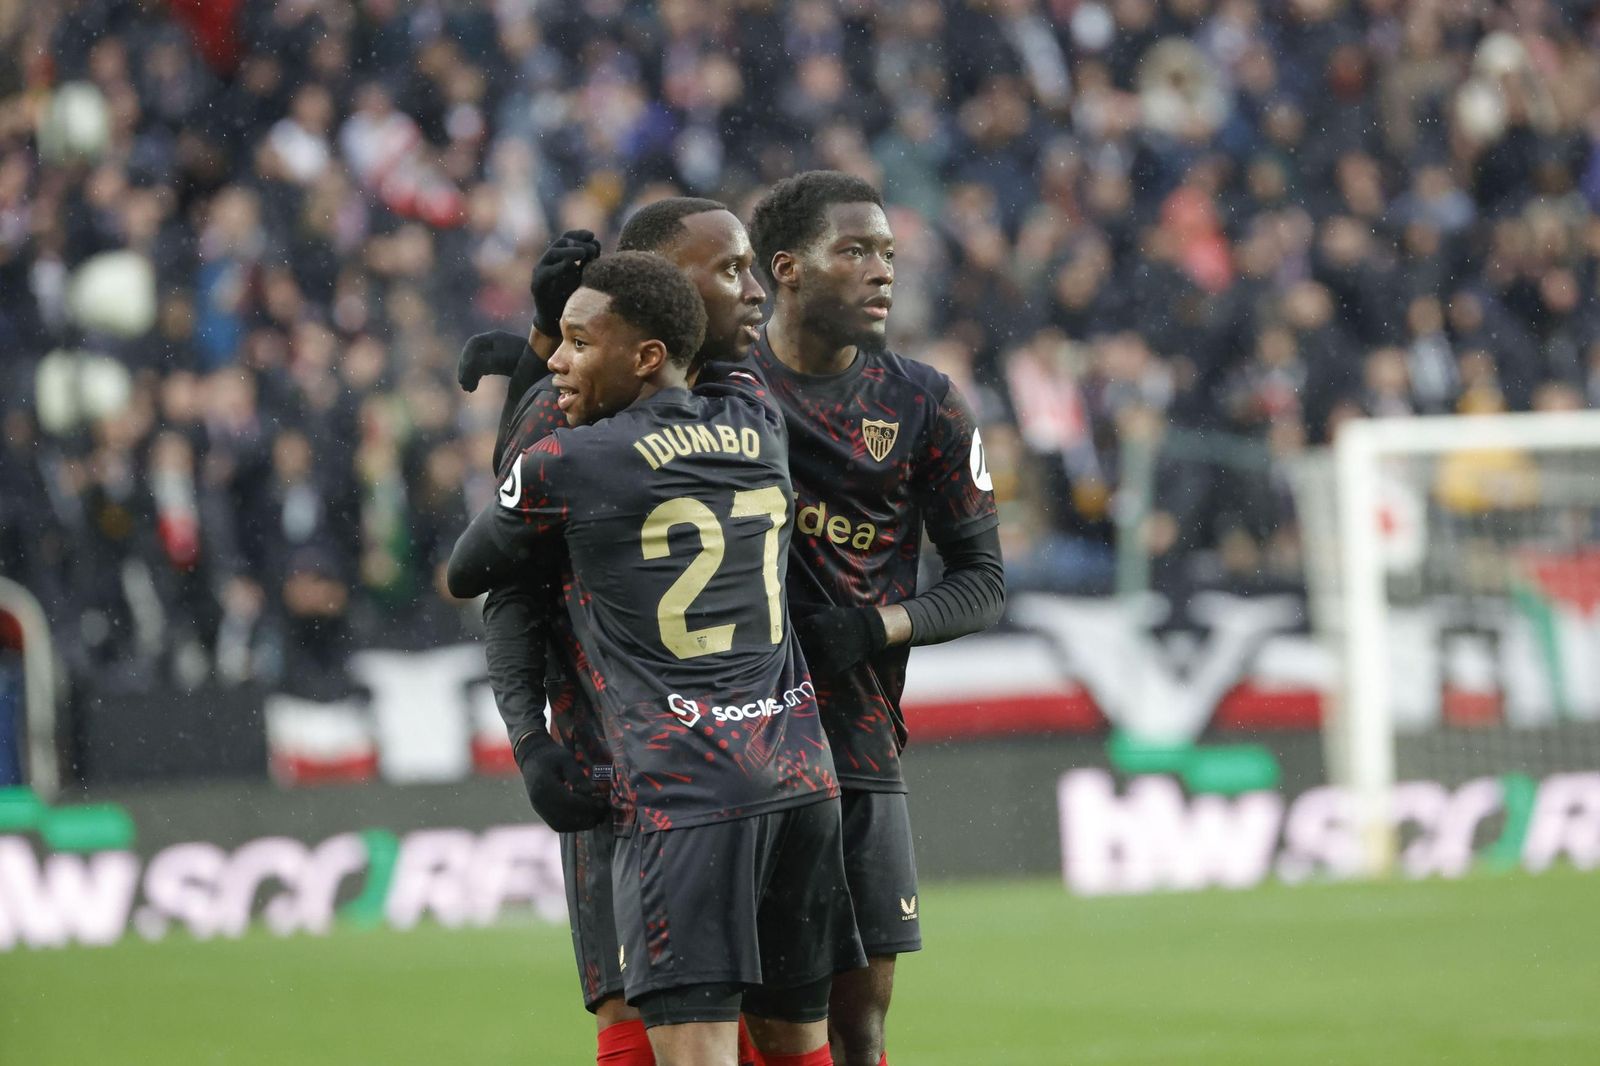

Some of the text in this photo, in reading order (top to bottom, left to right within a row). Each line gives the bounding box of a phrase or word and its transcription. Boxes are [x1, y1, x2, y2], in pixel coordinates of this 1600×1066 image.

[633, 424, 761, 470] IDUMBO
[794, 491, 876, 550] dea
[641, 486, 788, 660] 27
